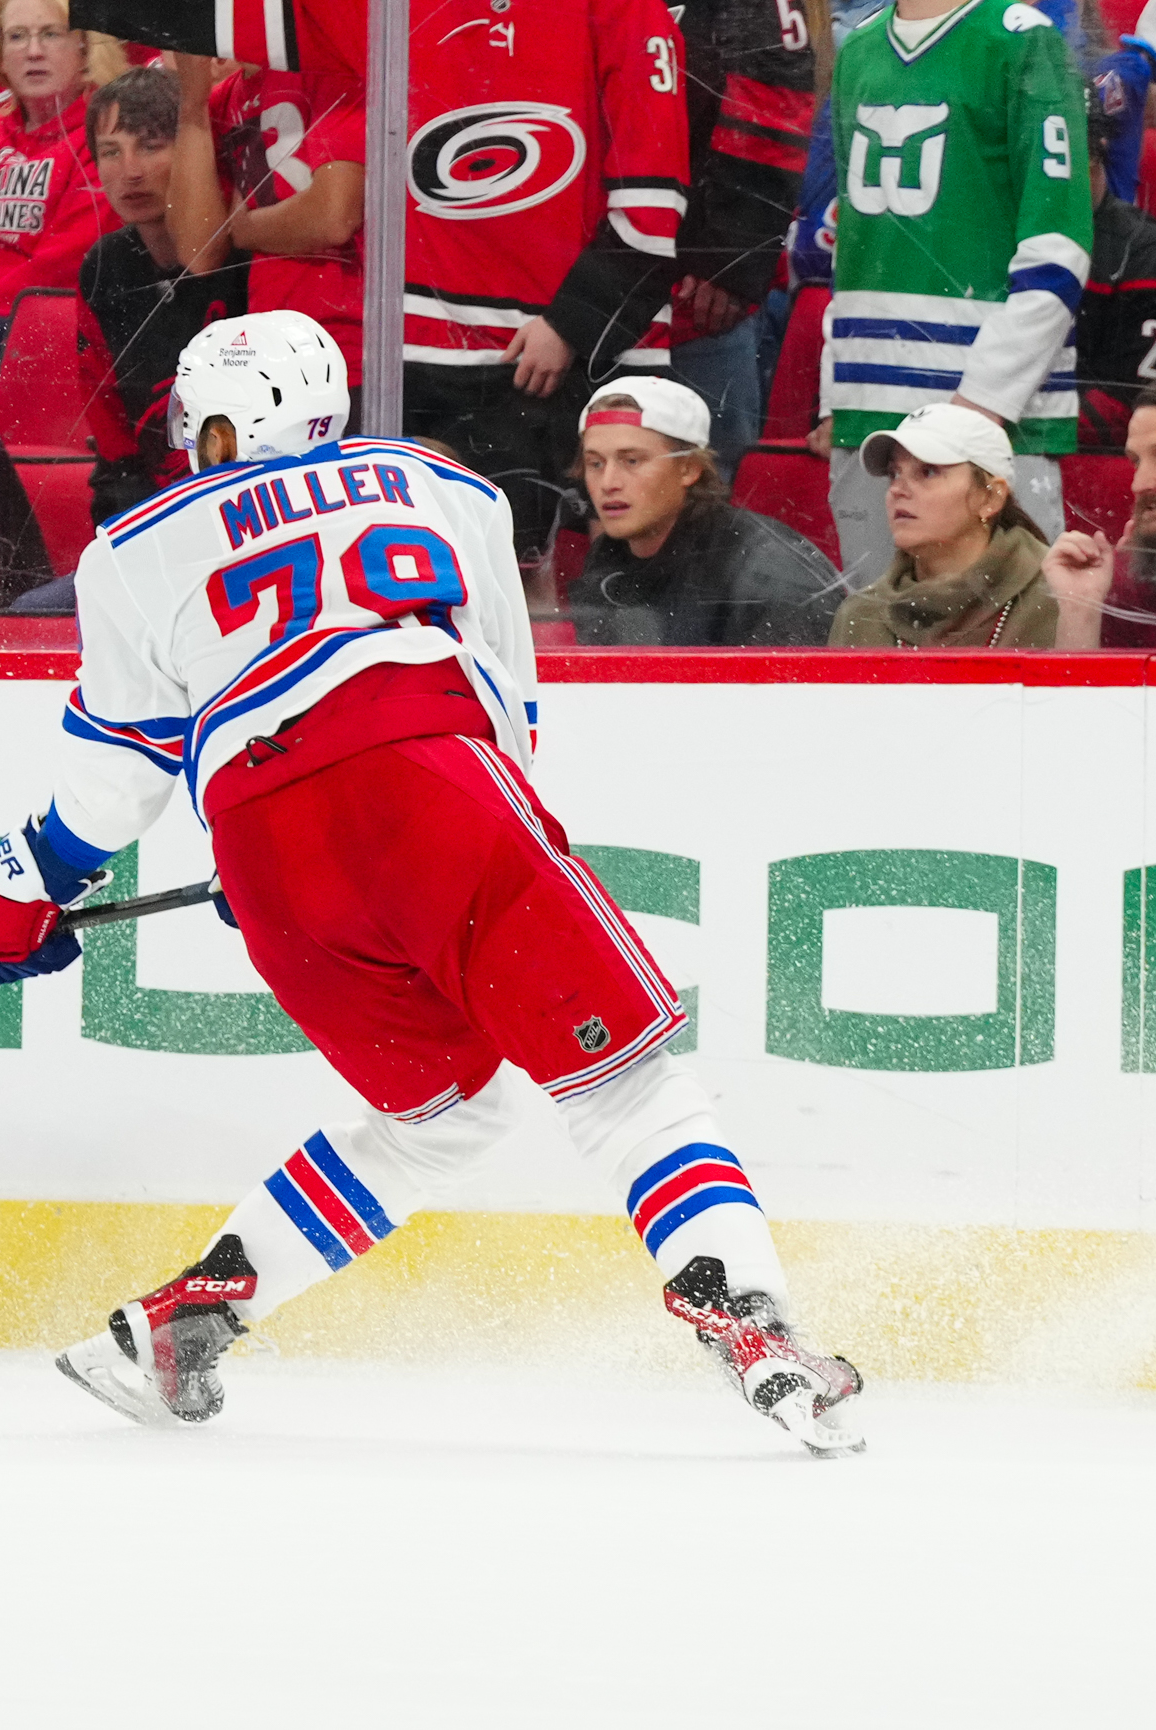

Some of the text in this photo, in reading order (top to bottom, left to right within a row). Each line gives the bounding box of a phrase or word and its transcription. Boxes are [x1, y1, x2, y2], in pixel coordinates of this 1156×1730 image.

[1043, 115, 1072, 179] 9
[219, 348, 256, 357] Benjamin
[223, 357, 249, 366] Moore
[307, 415, 333, 440] 79
[219, 464, 415, 551] MILLER
[206, 524, 468, 645] 79
[185, 1280, 246, 1292] CCM
[673, 1298, 730, 1328] CCM
